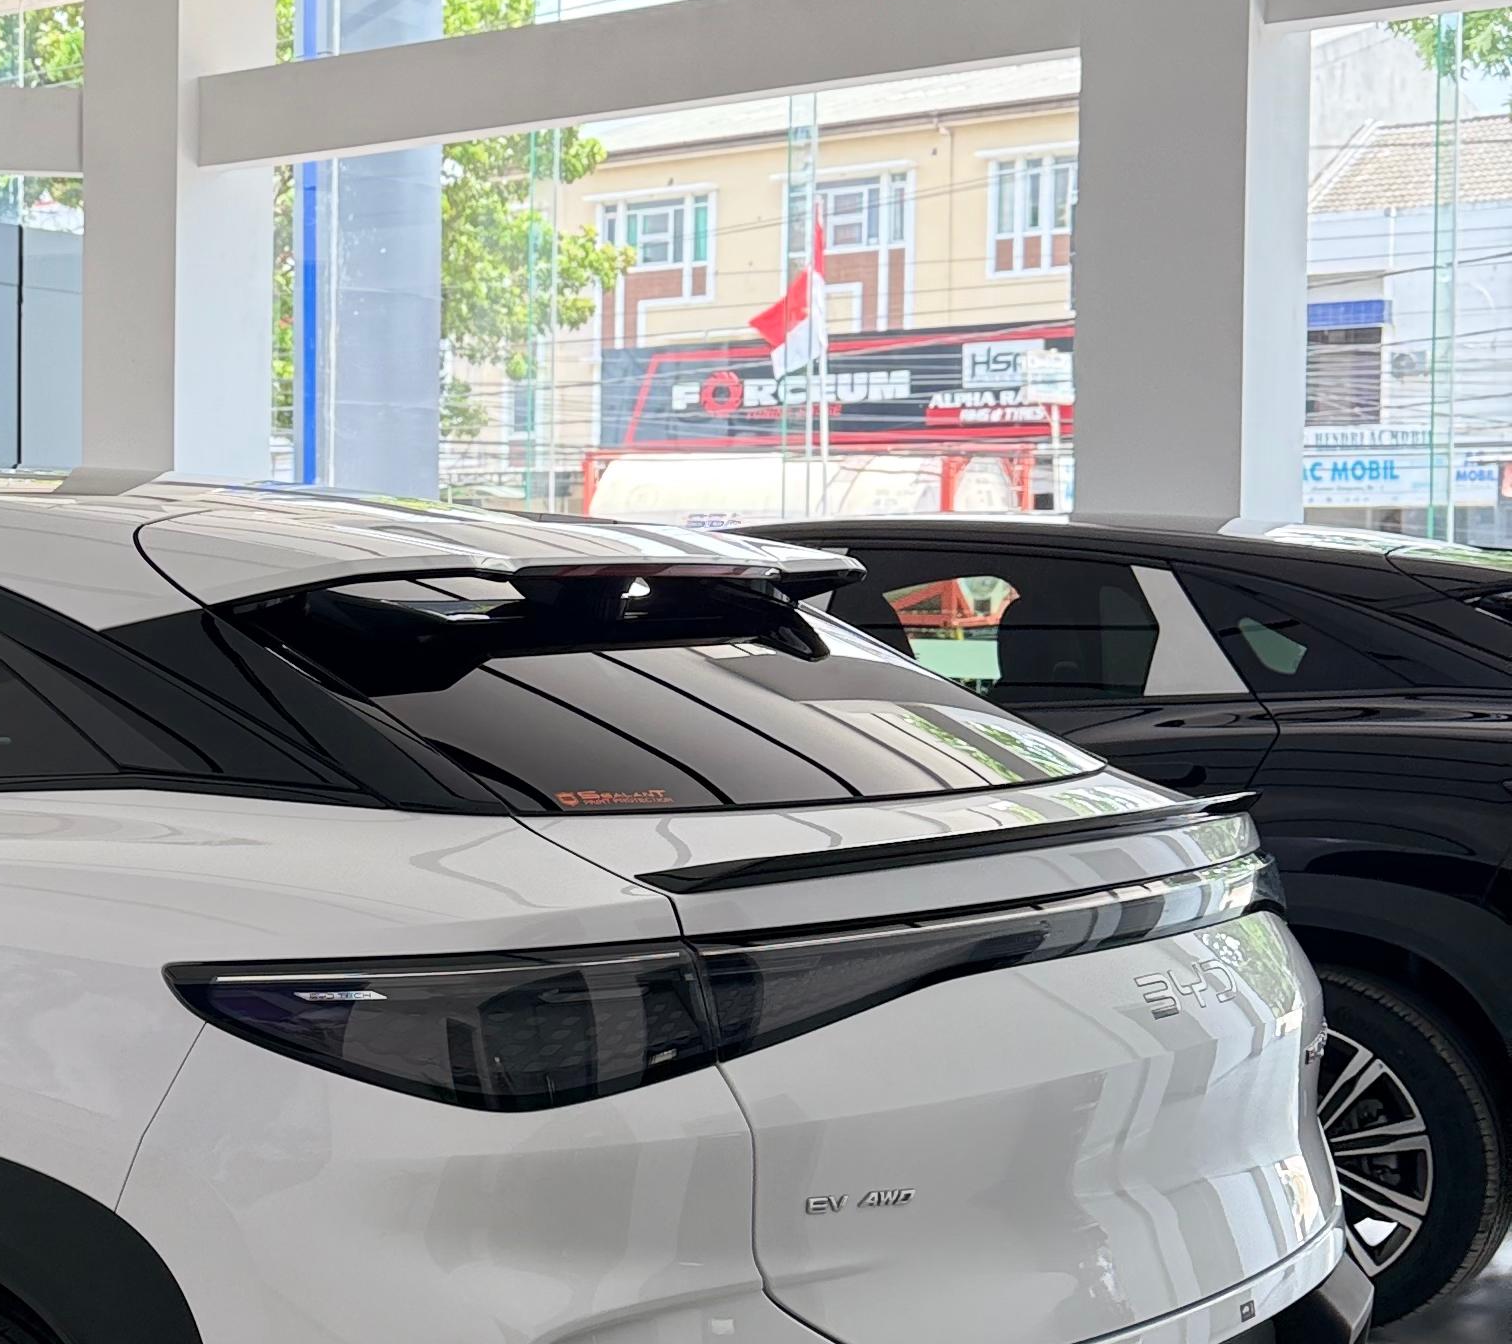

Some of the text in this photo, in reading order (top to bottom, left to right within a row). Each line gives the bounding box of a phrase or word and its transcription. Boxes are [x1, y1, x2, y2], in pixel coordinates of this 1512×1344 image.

[927, 390, 997, 409] ALPHA
[1331, 459, 1400, 481] MOBIL
[1455, 468, 1497, 482] MOBIL
[1133, 959, 1240, 1020] BYD
[805, 1188, 916, 1216] EV AWD
